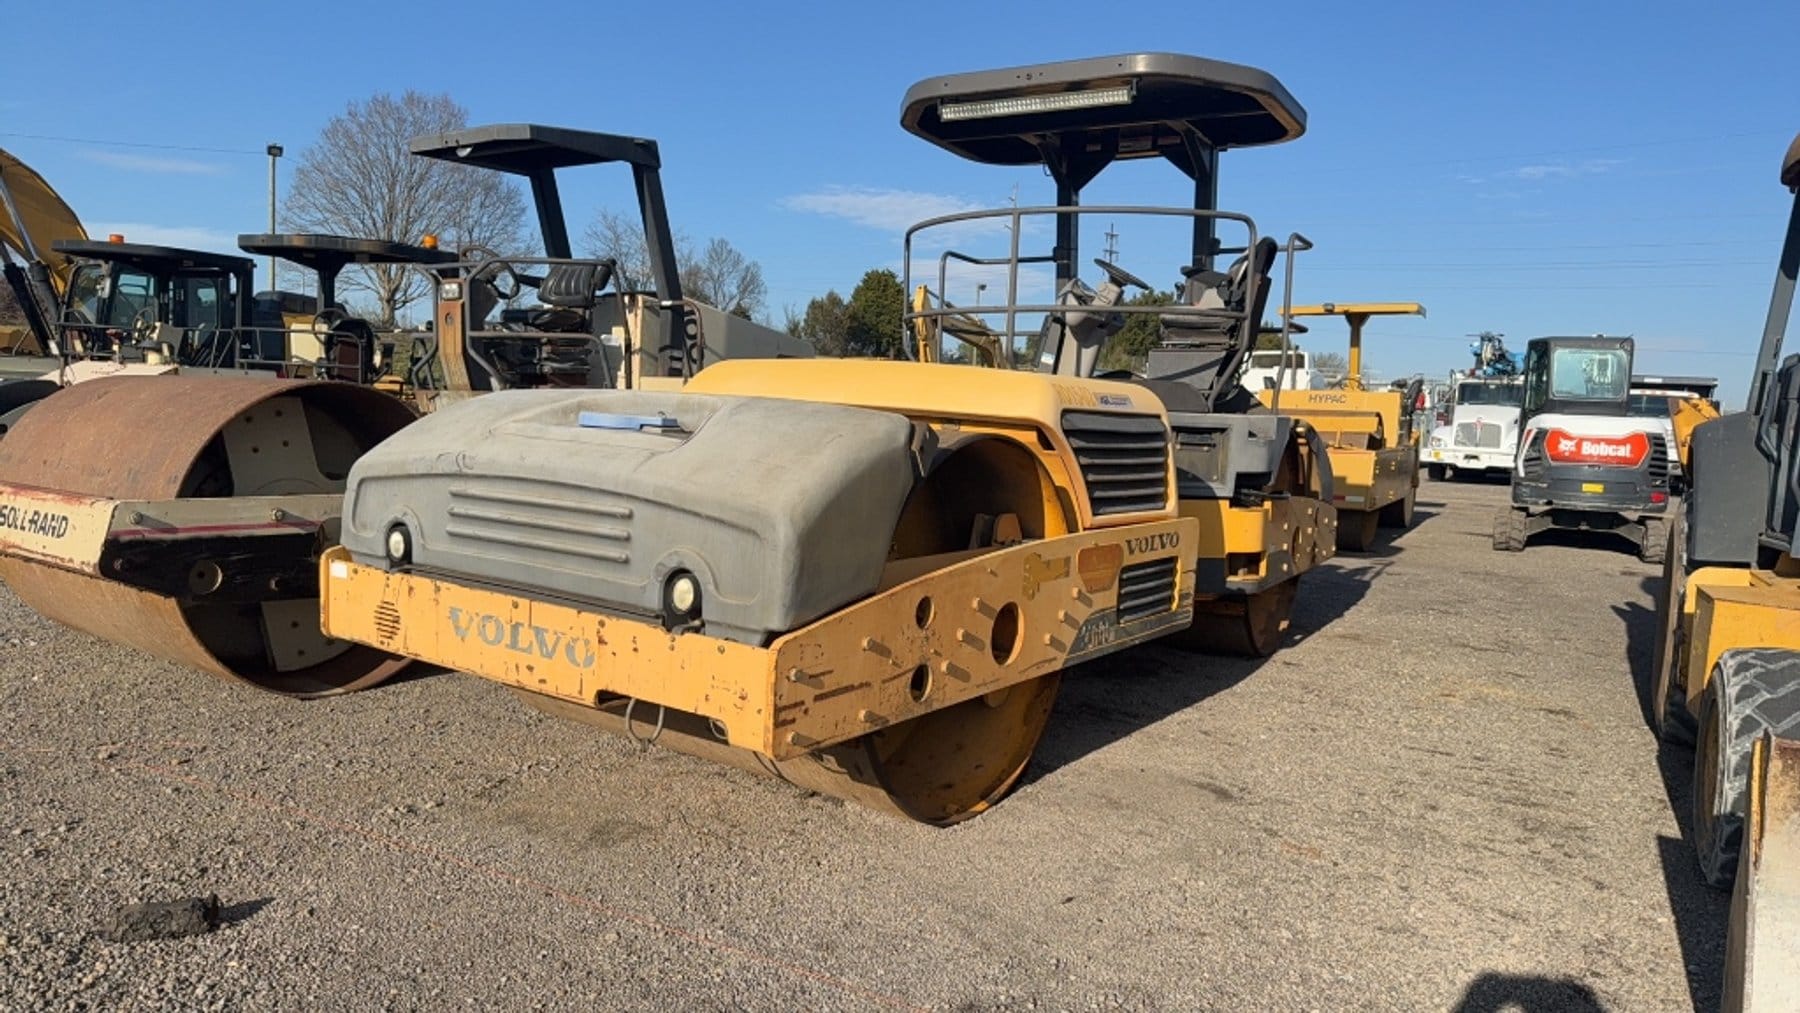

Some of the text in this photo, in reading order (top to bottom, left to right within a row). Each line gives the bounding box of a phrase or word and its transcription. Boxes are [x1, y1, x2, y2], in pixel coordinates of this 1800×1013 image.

[1308, 393, 1347, 404] HYPAC
[1580, 440, 1633, 458] Bobcat
[1125, 531, 1180, 556] VOLVO
[448, 606, 596, 669] VOLVO
